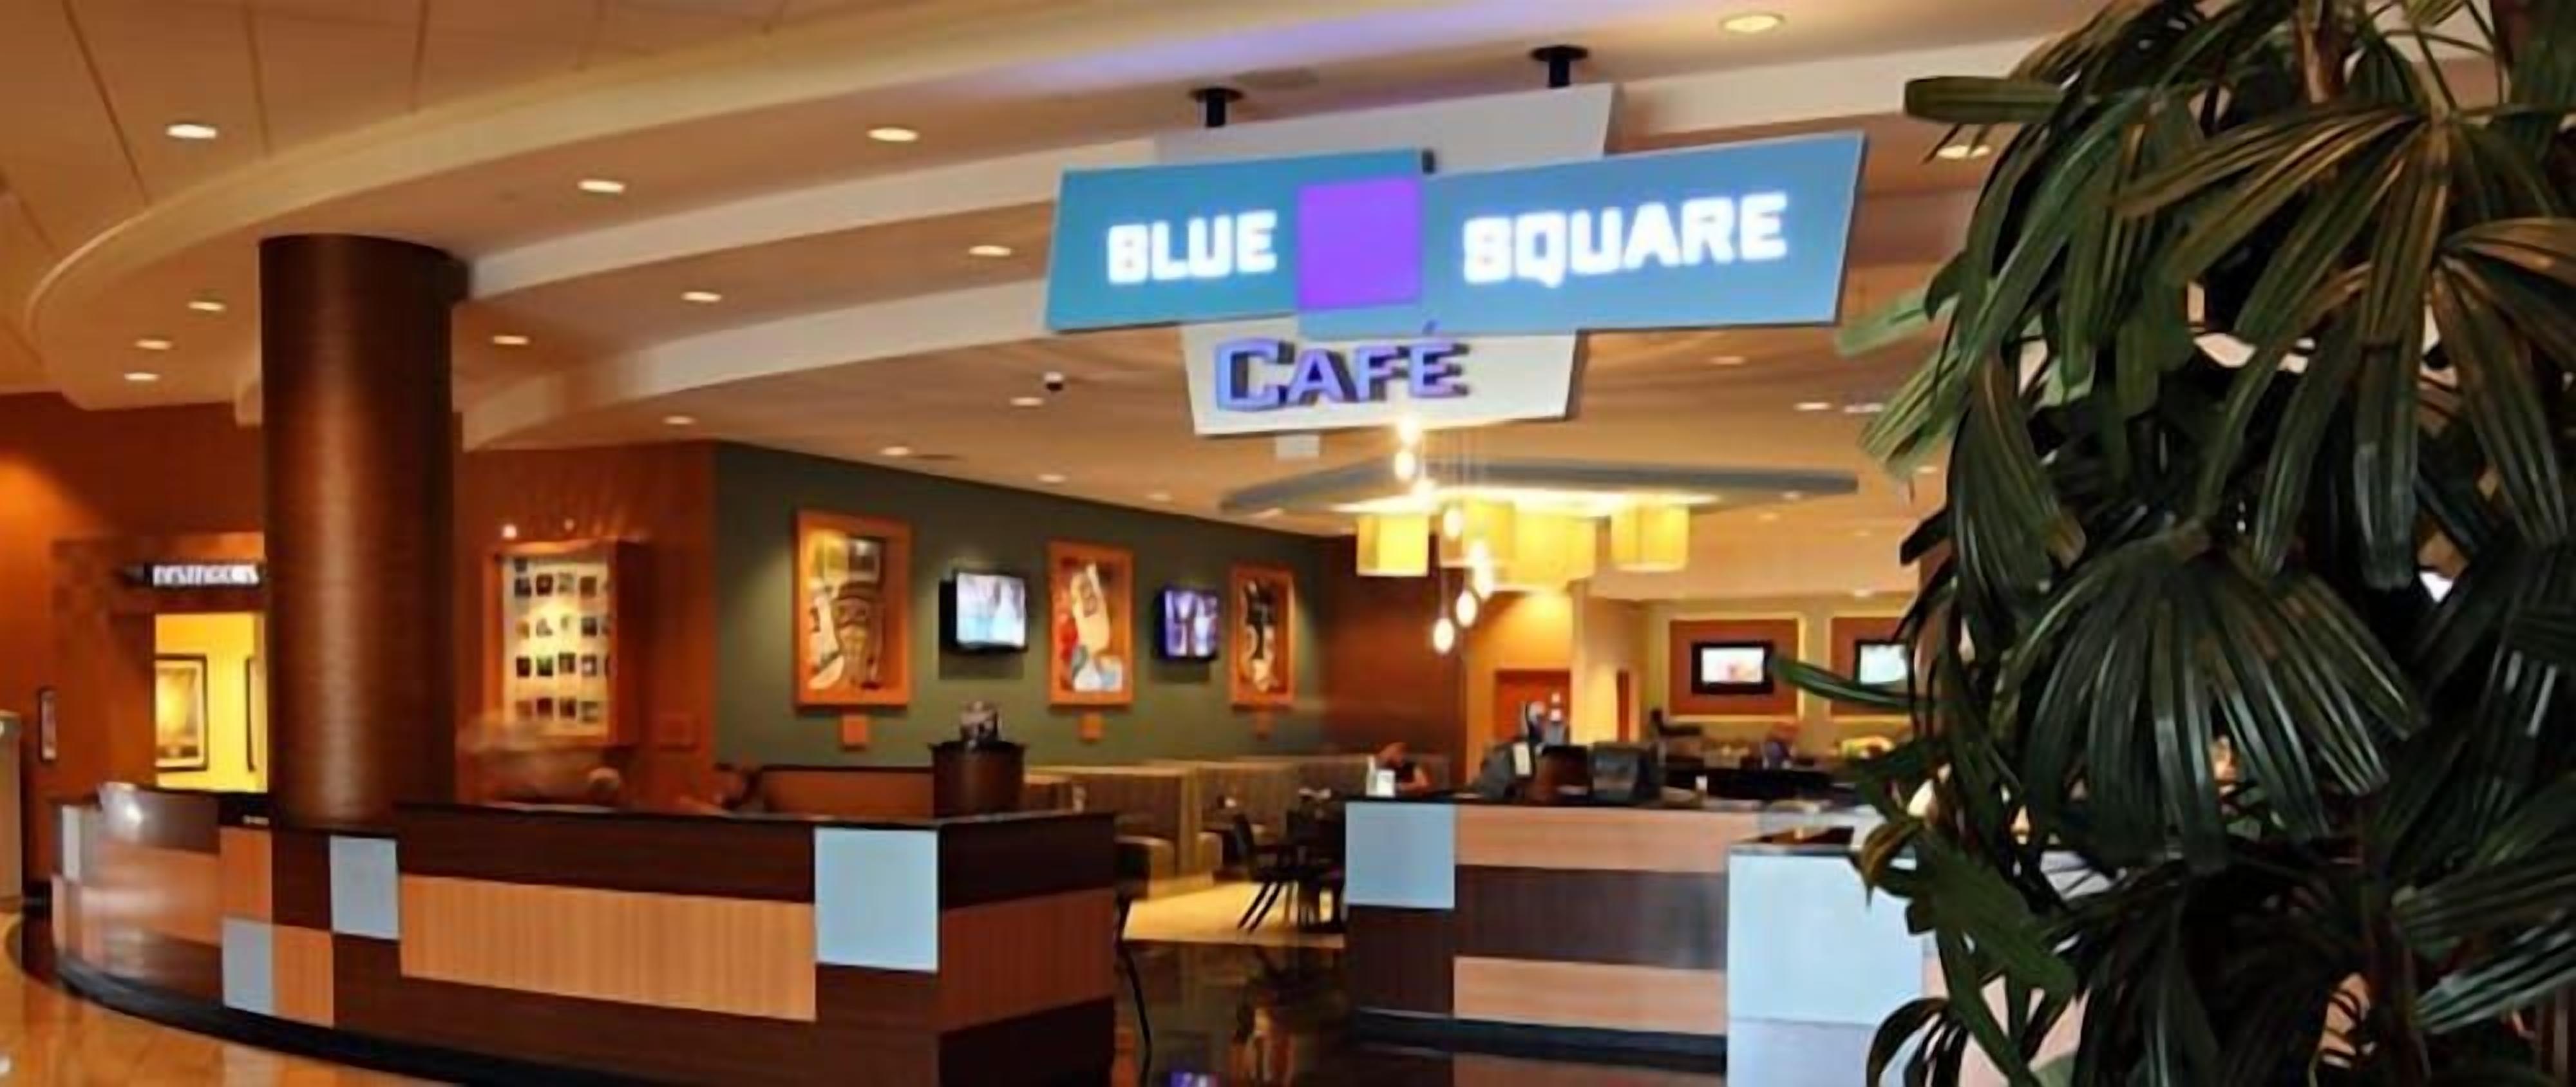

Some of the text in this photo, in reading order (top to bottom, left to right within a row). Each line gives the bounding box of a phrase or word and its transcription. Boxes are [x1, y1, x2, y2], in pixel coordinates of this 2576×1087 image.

[1107, 192, 1788, 288] BLUE SQUARE
[1215, 319, 1467, 412] CAFÉ
